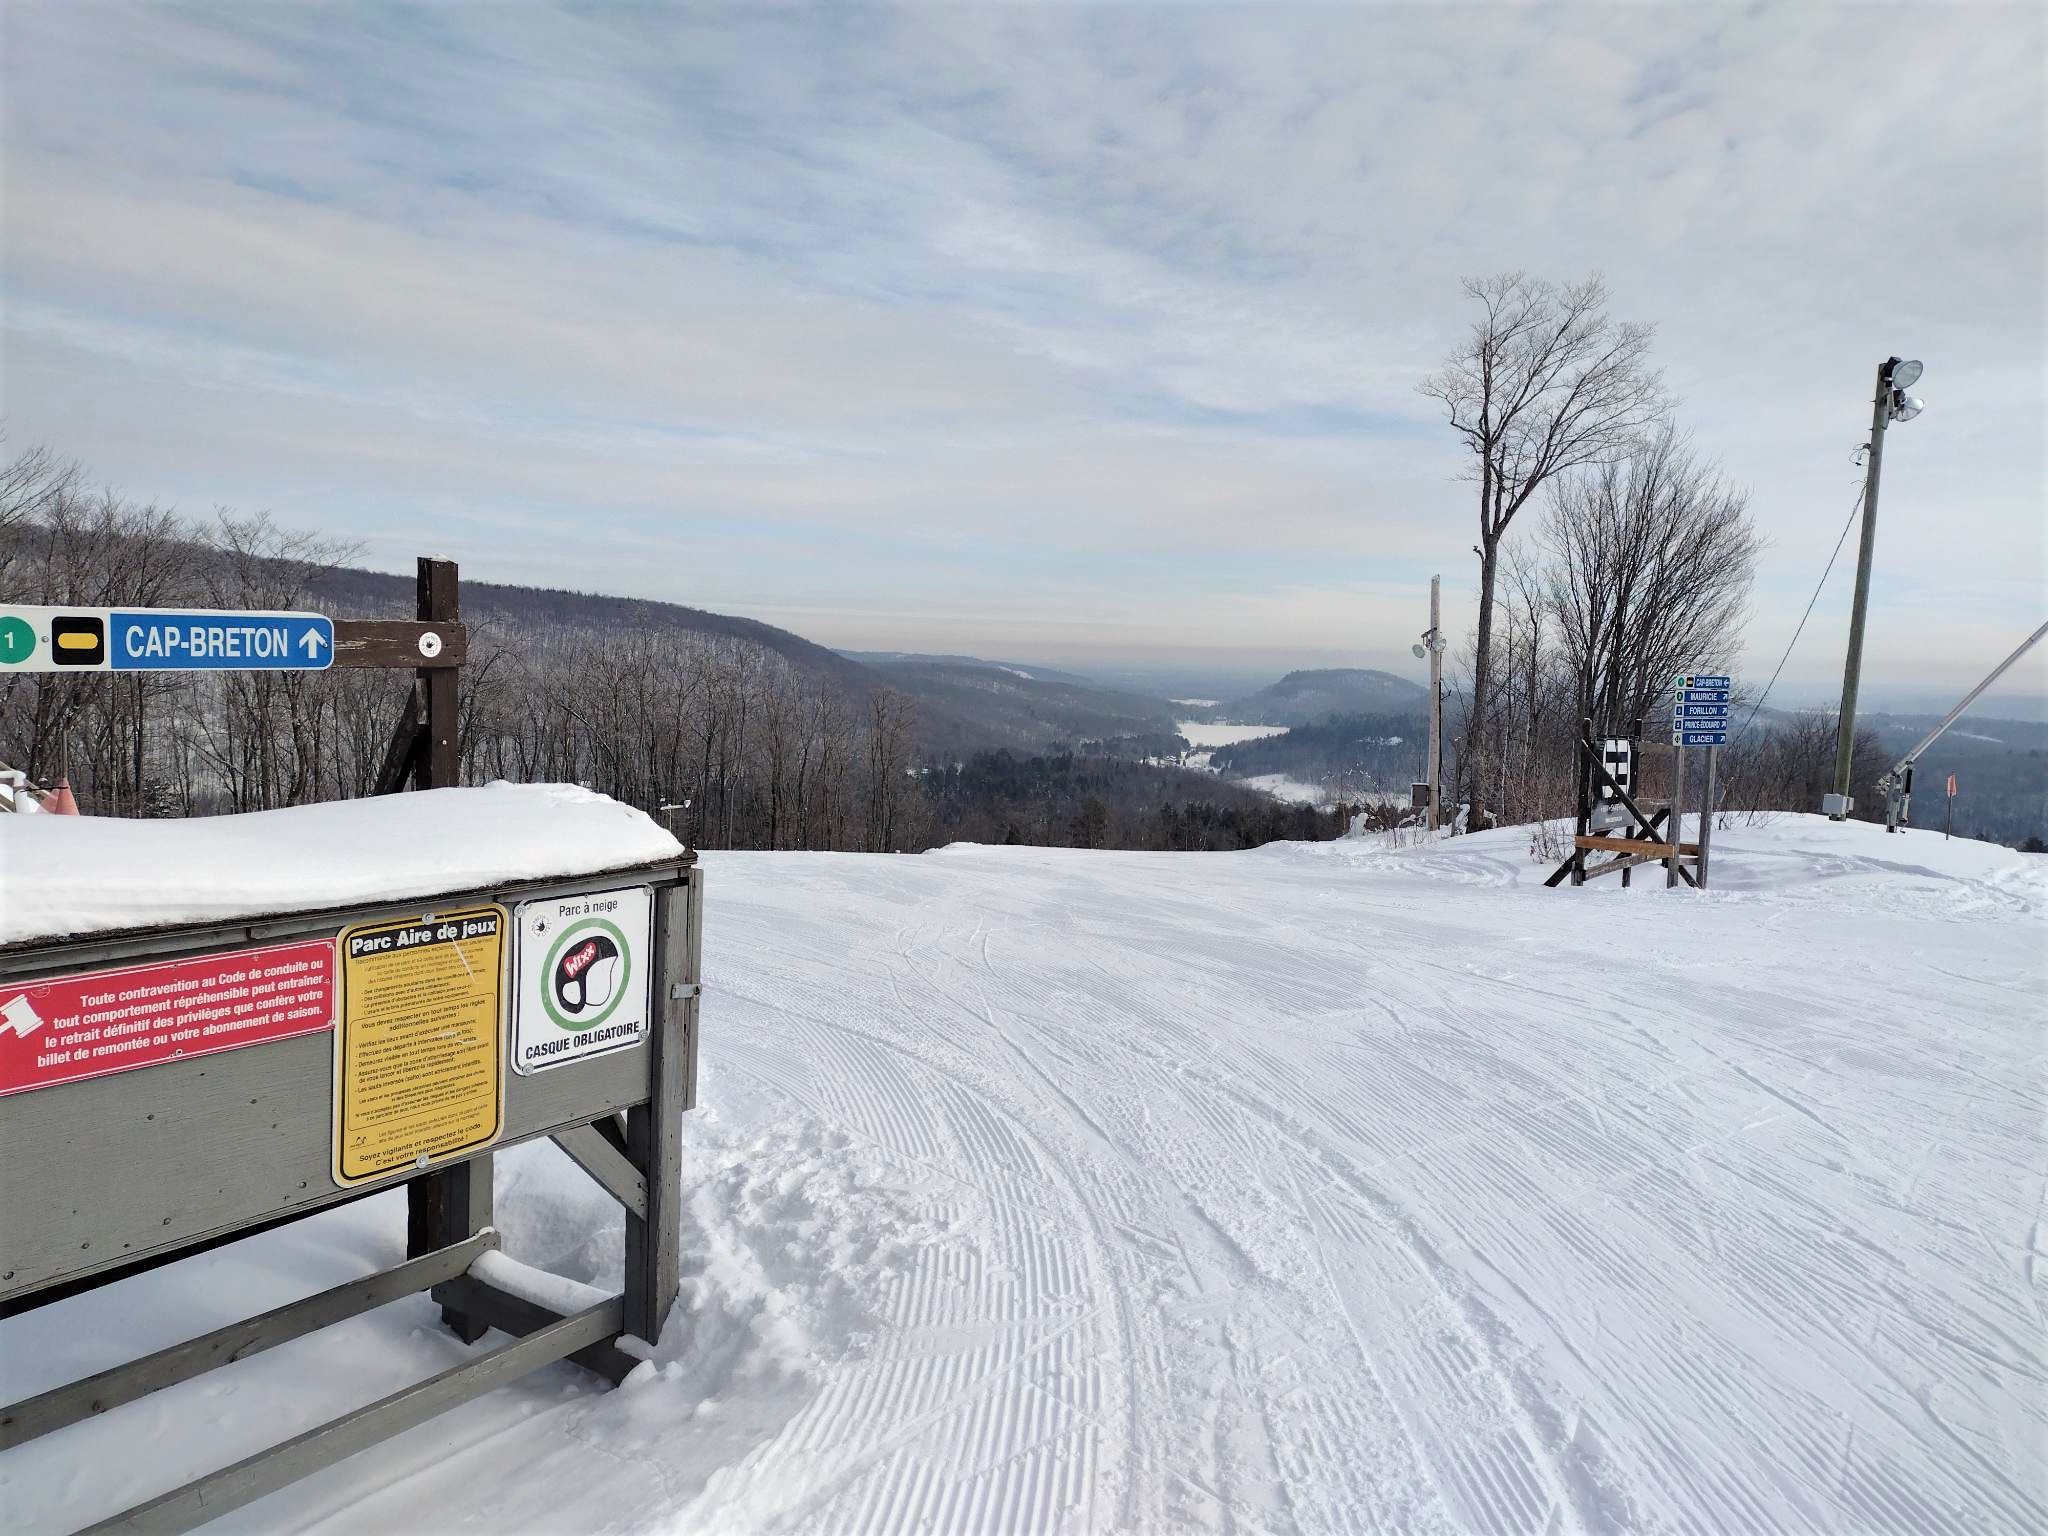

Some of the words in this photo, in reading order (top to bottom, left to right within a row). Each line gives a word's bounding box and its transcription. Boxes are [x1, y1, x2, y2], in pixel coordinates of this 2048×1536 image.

[4, 631, 14, 649] 1
[125, 625, 288, 658] CAP-BRETON
[1696, 679, 1722, 687] CAP-BRETON
[559, 905, 581, 918] Parc
[584, 902, 590, 913] à
[592, 899, 618, 914] neige
[350, 937, 391, 953] Parc
[396, 929, 431, 945] Aire
[436, 924, 457, 938] de
[461, 921, 496, 937] jeux
[80, 992, 116, 1008] Toute
[118, 978, 200, 1002] contravention
[202, 977, 216, 988] au
[218, 970, 246, 986] Code
[248, 968, 262, 981] de
[263, 960, 309, 979] conduite
[310, 959, 323, 971] ou
[53, 1016, 80, 1030] tout
[82, 1000, 171, 1027] comportement
[173, 986, 249, 1010] répréhensible
[251, 982, 276, 998] peut
[277, 974, 324, 991] entraîner
[394, 1013, 421, 1021] respecter
[45, 1036, 57, 1049] le
[61, 1026, 101, 1047] retrait
[103, 1020, 151, 1040] définitif
[153, 1017, 174, 1032] des
[176, 1006, 231, 1026] privilèges
[233, 1002, 254, 1017] que
[256, 997, 296, 1012] confère
[297, 989, 323, 1003] votre
[389, 1019, 428, 1030] additionnelles
[430, 1012, 456, 1022] suivantes
[37, 1051, 71, 1067] billet
[74, 1047, 89, 1062] de
[92, 1035, 151, 1057] remontée
[153, 1033, 168, 1046] ou
[171, 1028, 200, 1043] votre
[202, 1015, 270, 1036] abonnement
[271, 1011, 285, 1024] de
[287, 1004, 323, 1020] saison.
[526, 1038, 570, 1060] CASQUE
[573, 1021, 639, 1047] OBLIGATOIRE
[359, 1152, 381, 1161] Soyez
[382, 1143, 412, 1155] vigilants
[422, 1131, 456, 1143] respectez
[395, 1151, 413, 1159] votre
[415, 1136, 464, 1153] responsabilité
